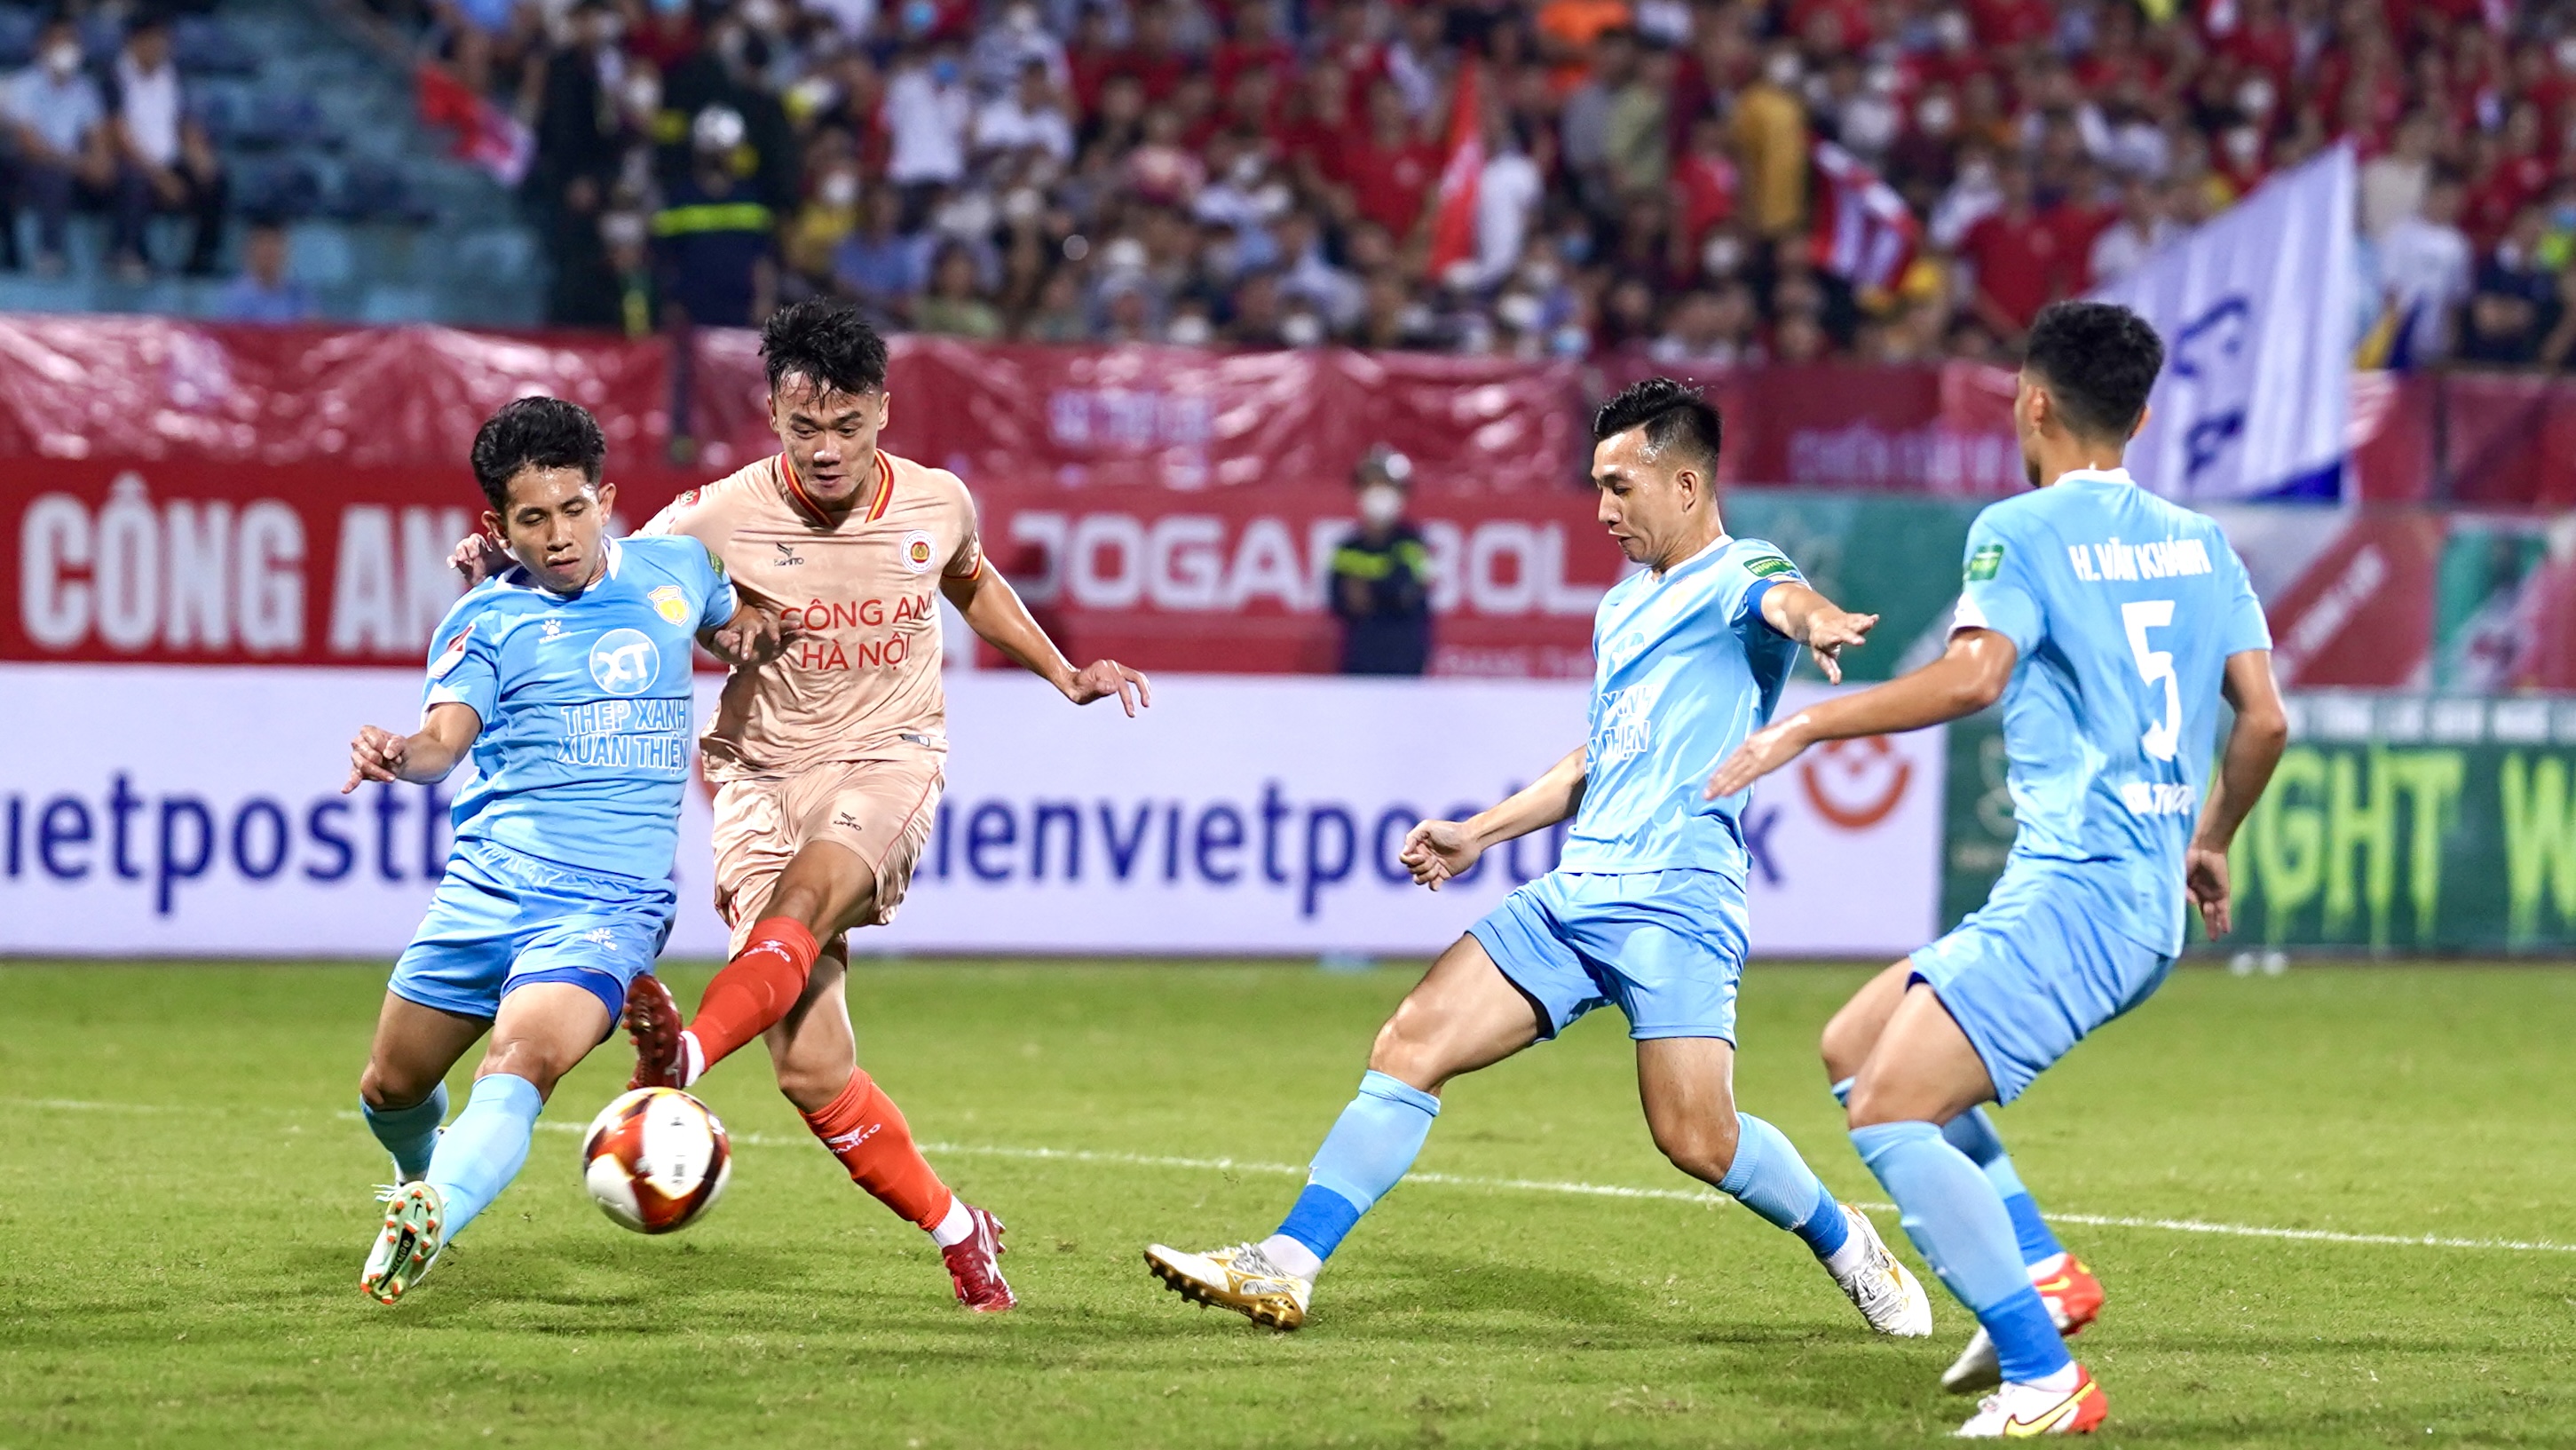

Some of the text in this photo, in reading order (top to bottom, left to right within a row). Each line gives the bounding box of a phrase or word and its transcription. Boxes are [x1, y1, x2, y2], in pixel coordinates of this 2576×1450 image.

[20, 471, 307, 651] CÔNG
[1010, 511, 1608, 614] JOGABOL
[636, 698, 686, 730] XANH
[802, 631, 911, 671] HÀ NỘI
[2122, 599, 2182, 762] 5
[2221, 742, 2466, 955] GHT
